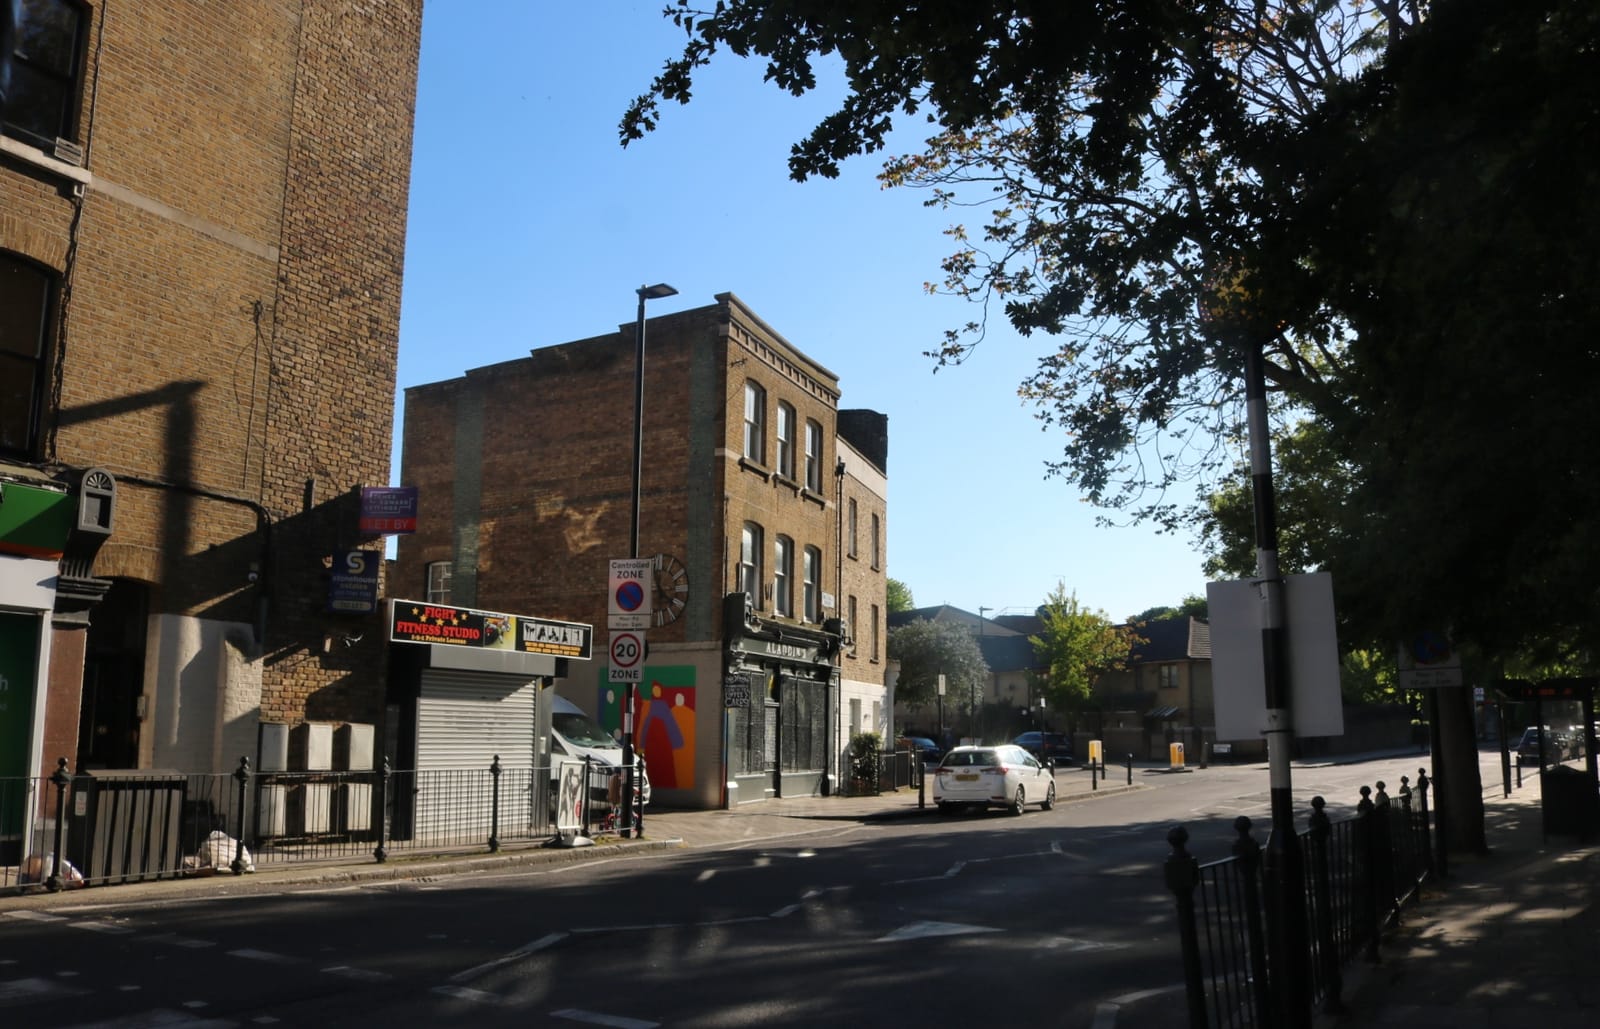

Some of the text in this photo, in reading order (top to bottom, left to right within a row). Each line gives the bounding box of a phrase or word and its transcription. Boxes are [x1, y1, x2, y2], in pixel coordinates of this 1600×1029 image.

[367, 519, 409, 530] LET BY
[611, 561, 649, 569] Controlled
[617, 570, 644, 579] ZONE
[425, 607, 457, 620] FIGHT
[397, 621, 480, 639] FITNESS STUDIO
[615, 643, 637, 658] 20
[611, 669, 639, 679] ZONE
